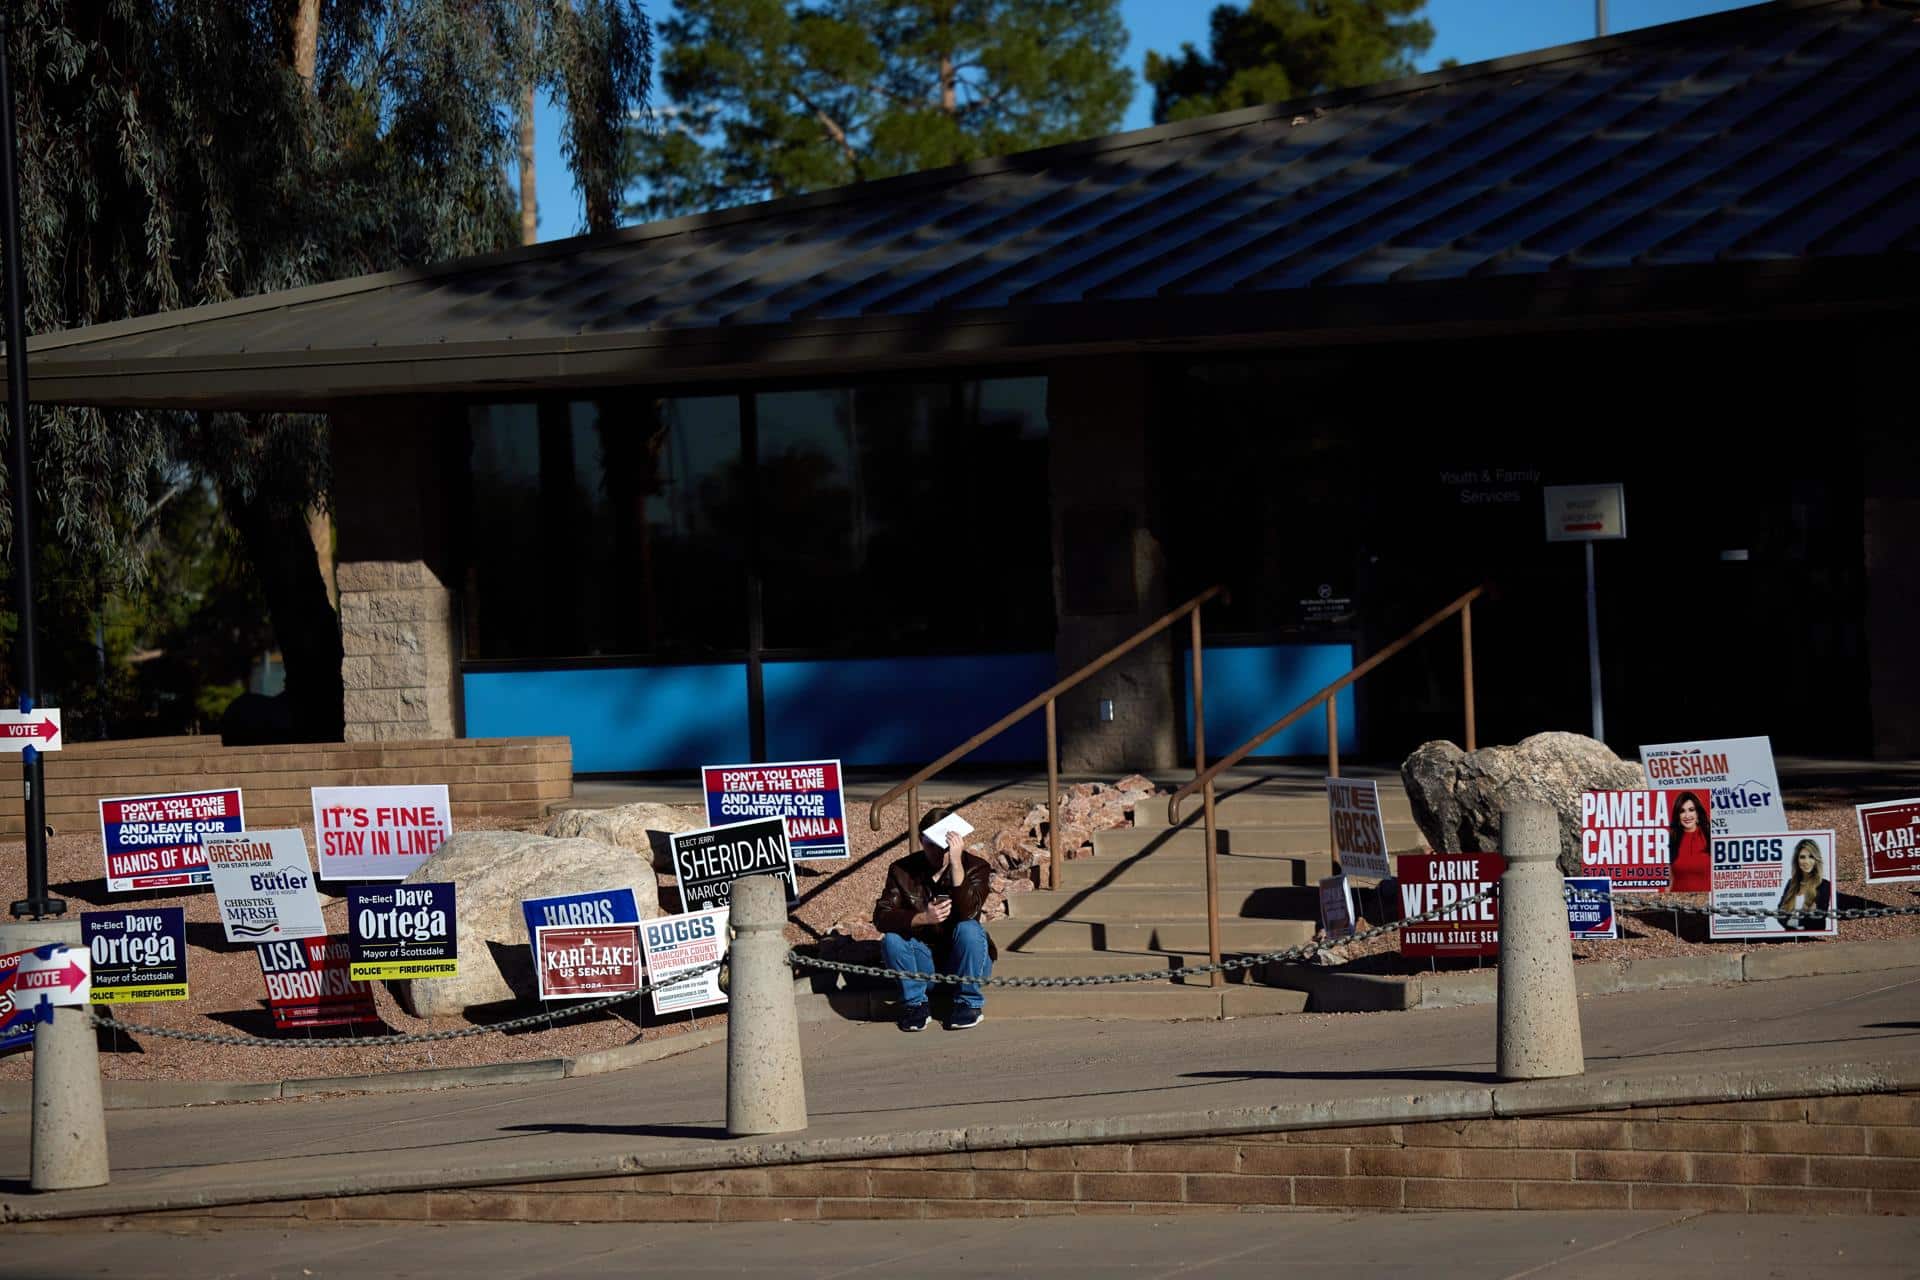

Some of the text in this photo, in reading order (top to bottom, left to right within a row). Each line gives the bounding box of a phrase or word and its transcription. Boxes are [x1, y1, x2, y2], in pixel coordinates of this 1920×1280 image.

[1496, 467, 1541, 485] Family
[1460, 489, 1520, 503] Services
[8, 725, 39, 736] VOTE
[722, 767, 824, 782] DON'T YOU DARE
[1648, 753, 1729, 779] GRESHAM
[723, 777, 825, 793] LEAVE THE LINE
[1659, 778, 1674, 786] FOR
[1700, 775, 1727, 783] HOUSE
[121, 796, 225, 813] DON'T YOU DARE
[721, 793, 824, 805] AND LEAVE OUR
[122, 805, 226, 823] LEAVE THE LINE
[321, 807, 443, 828] IT'S FINE.
[721, 804, 825, 816] COUNTRY IN THE
[1581, 791, 1669, 828] PAMELA
[119, 821, 225, 835] AND LEAVE OUR
[1334, 810, 1381, 856] GRESS
[119, 833, 198, 845] COUNTRY IN
[324, 829, 445, 856] STAY IN LINE!
[679, 833, 715, 848] ELECT JERRY
[1582, 828, 1670, 865] CARTER
[1872, 827, 1915, 853] KARI
[208, 842, 273, 863] GRESHAM
[680, 834, 787, 880] SHERIDAN
[1714, 838, 1783, 863] BOGGS
[1887, 848, 1904, 859] US
[113, 852, 158, 875] HANDS
[161, 848, 179, 867] OF
[1429, 860, 1479, 881] CARINE
[1583, 867, 1670, 877] STATE HOUSE
[1714, 869, 1783, 880] MARICOPA COUNTY
[250, 872, 307, 891] Butler
[1714, 878, 1783, 889] SUPERINTENDENT
[358, 888, 433, 907] Re-Elect Dave
[687, 881, 732, 902] MARICO
[224, 898, 274, 907] CHRISTINE
[1401, 882, 1499, 921] WERNE
[543, 899, 615, 926] HARRIS
[1569, 911, 1601, 921] BEHIND!
[91, 915, 162, 933] Re-Elect Dave
[358, 906, 447, 940] Ortega
[647, 916, 715, 947] BOGGS
[1405, 931, 1444, 944] ARIZONA
[1448, 931, 1477, 943] STATE
[91, 932, 176, 966] Ortega
[257, 941, 350, 971] LISA MAYOR
[363, 946, 445, 959] Mayor of Scottsdale
[547, 945, 633, 971] KARI LAKE
[651, 943, 718, 962] MARICOPA COUNTY
[353, 967, 382, 976] POLICE
[399, 963, 456, 974] FIREFIGHTERS
[652, 952, 719, 970] SUPERINTENDENT
[26, 970, 62, 987] VOTE
[96, 971, 174, 984] Mayor of Scottsdale
[560, 966, 621, 978] US SENATE
[131, 988, 186, 998] FIREFIGHTERS
